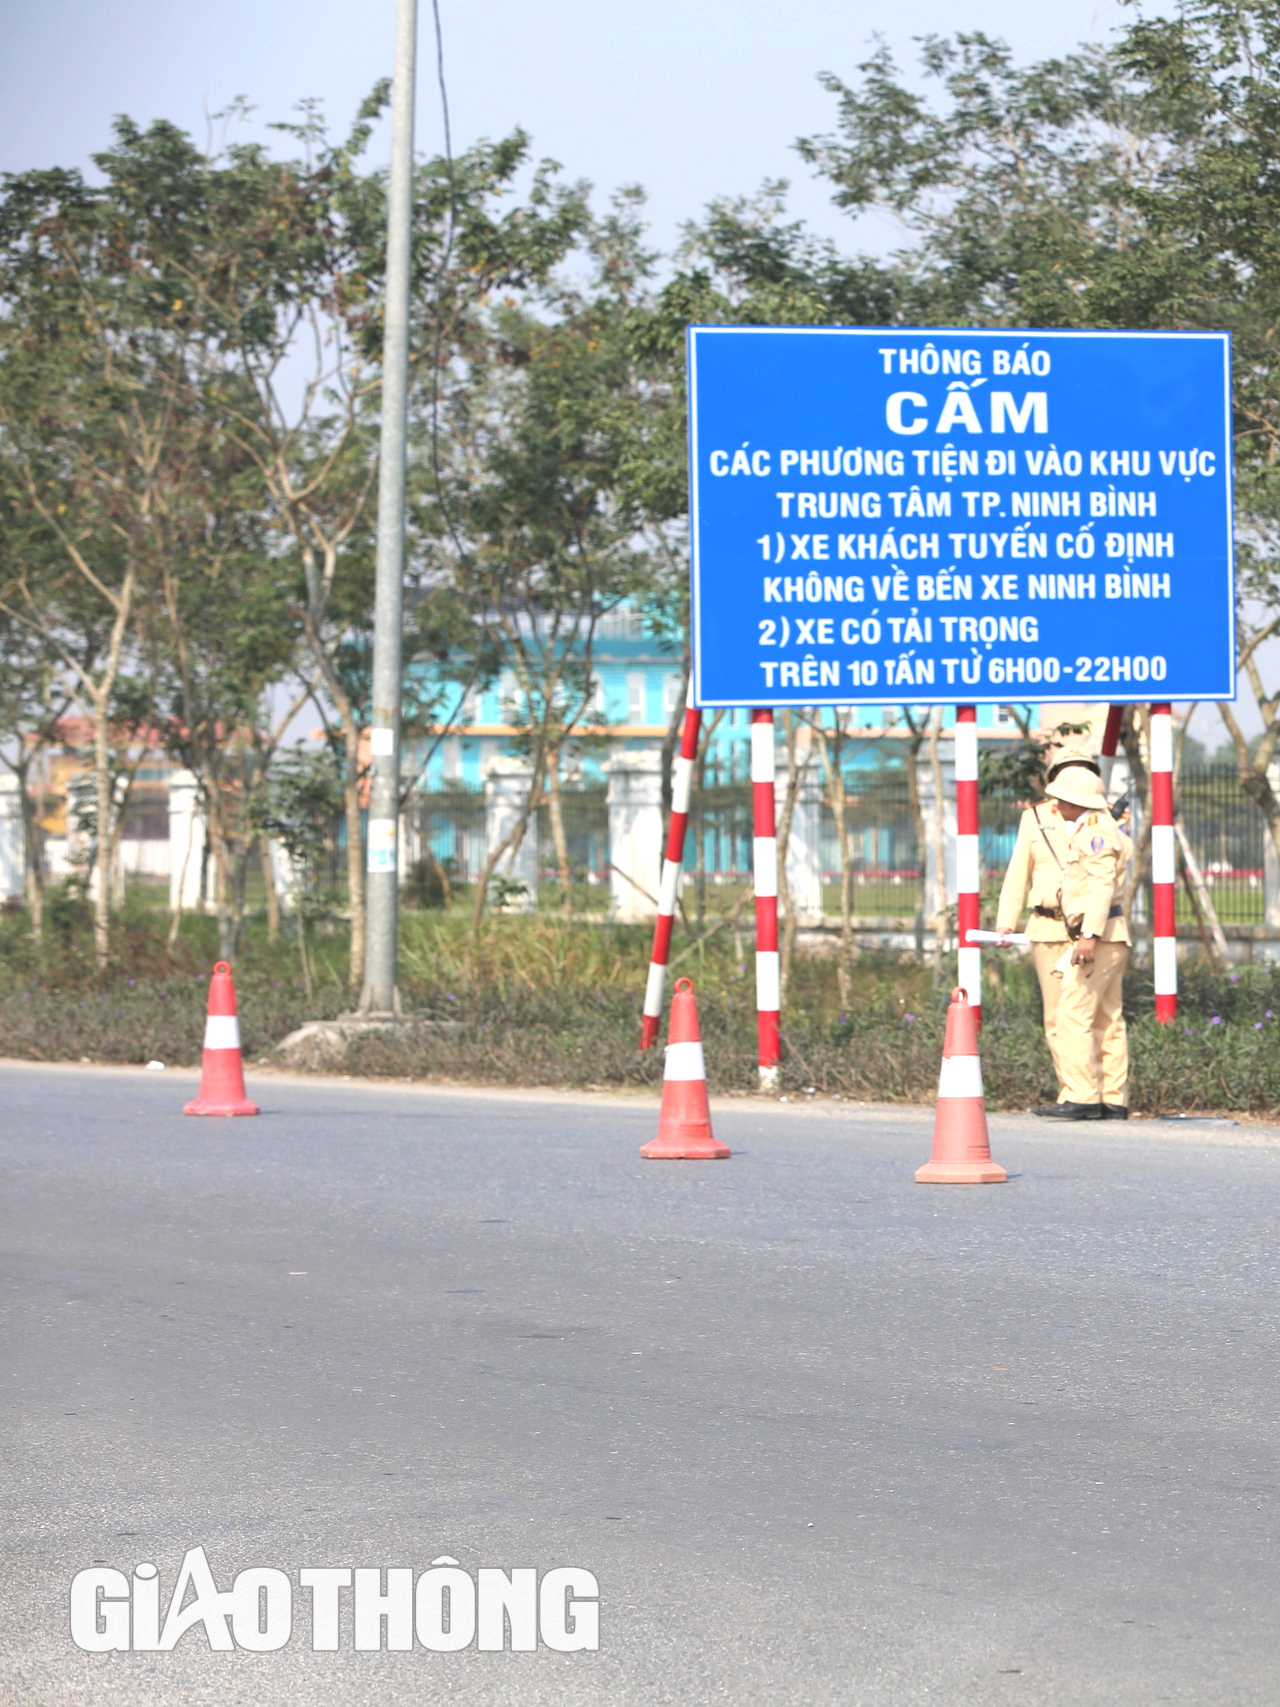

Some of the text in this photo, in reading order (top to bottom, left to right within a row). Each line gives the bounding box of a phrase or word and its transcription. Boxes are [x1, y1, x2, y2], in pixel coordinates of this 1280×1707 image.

[878, 341, 1051, 377] THÔNG BÁO
[885, 377, 1049, 436] CẤM
[709, 441, 1216, 483] CÁC PHƯƠNG TIỆN ĐI VÀO KHU VỰC
[775, 484, 1157, 519] TRUNG TÂM TP. NINH BÌNH
[837, 526, 940, 560] KHÁCH
[948, 521, 1048, 560] TUYẾN
[1055, 521, 1095, 559] CỐ
[1104, 532, 1175, 564] ĐỊNH
[763, 563, 1171, 603] KHÔNG VỀ BẾN XE NINH BÌNH
[840, 608, 882, 645] CÓ
[886, 606, 933, 644] TẢI
[938, 615, 1039, 650] TRỌNG
[759, 646, 1167, 688] TRÊN 10 TẤN TỪ 6H00-22H00
